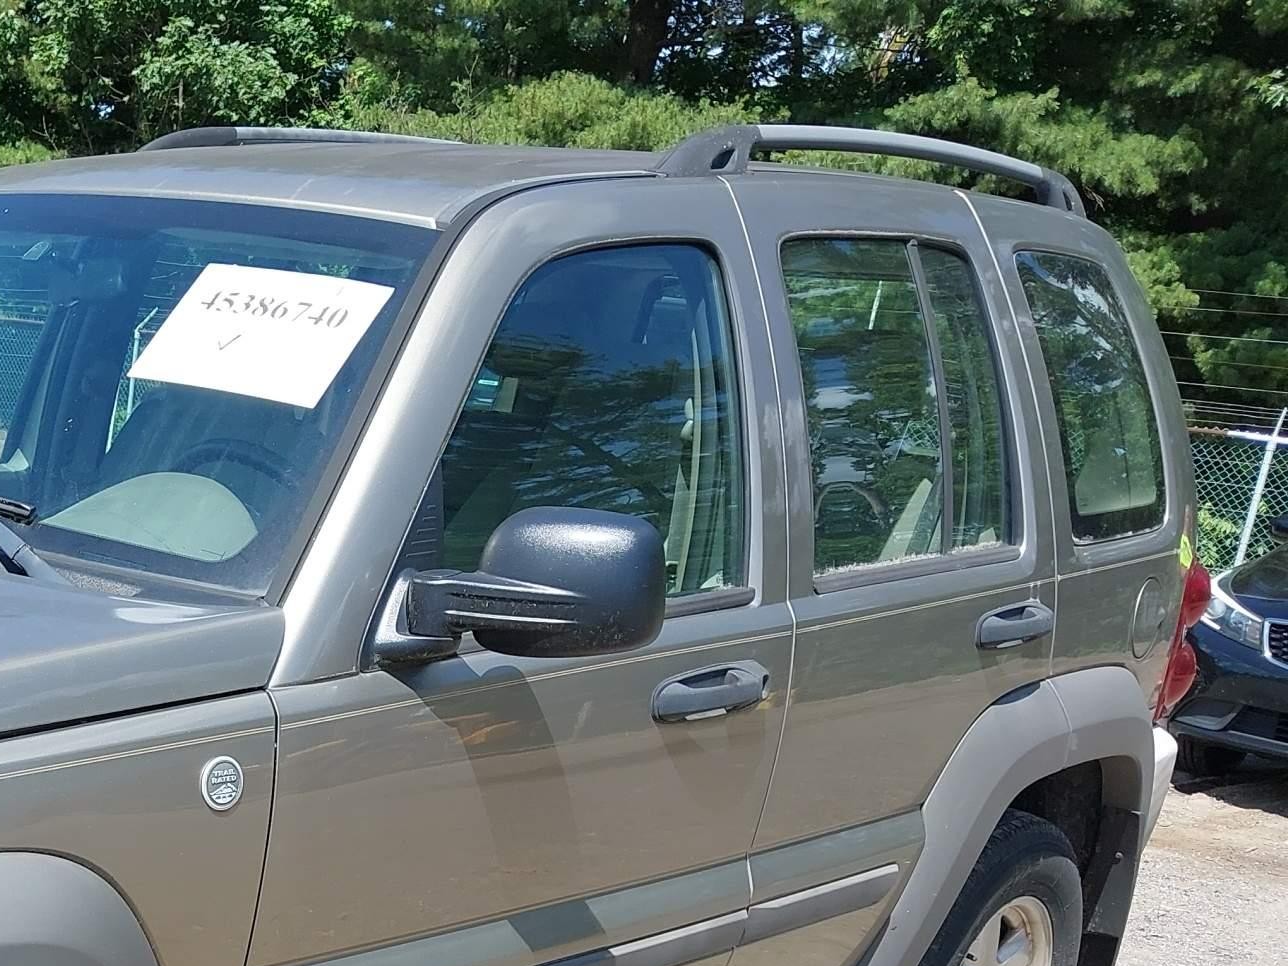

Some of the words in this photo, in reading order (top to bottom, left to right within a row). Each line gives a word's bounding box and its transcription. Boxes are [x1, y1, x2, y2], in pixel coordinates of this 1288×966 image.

[201, 290, 349, 329] 45386740
[212, 768, 236, 777] TRAIL
[211, 775, 238, 785] RATED
